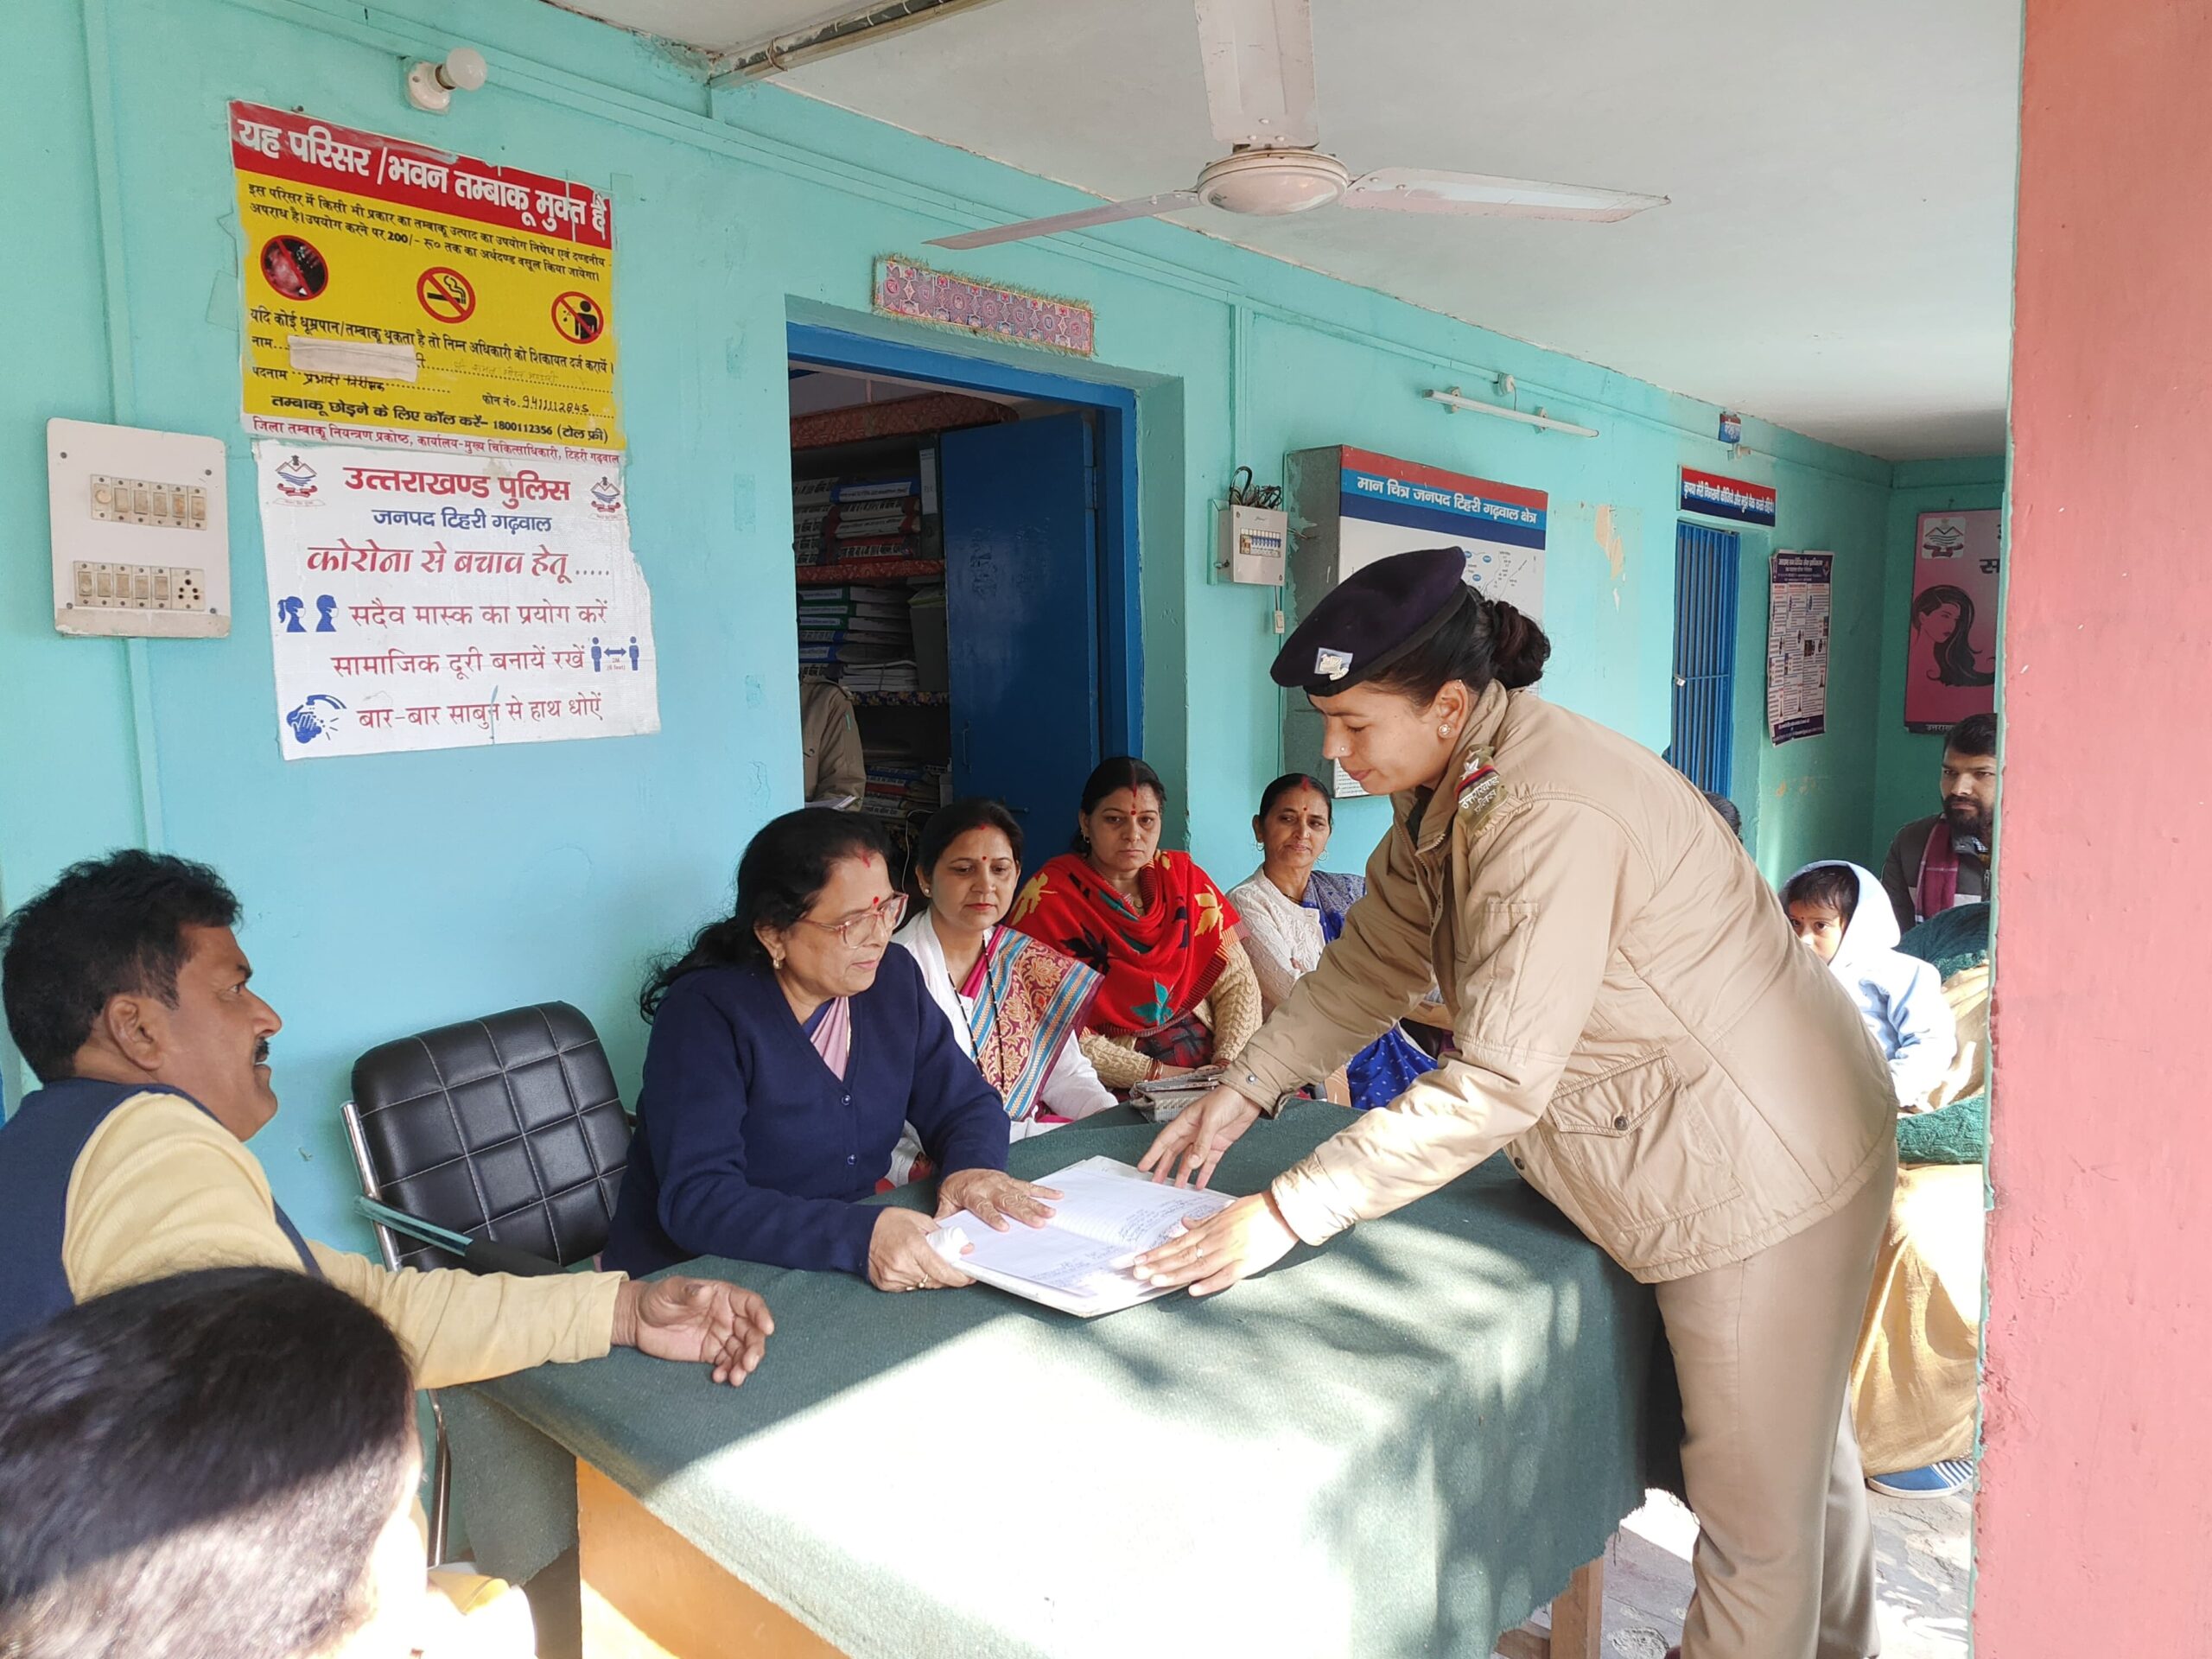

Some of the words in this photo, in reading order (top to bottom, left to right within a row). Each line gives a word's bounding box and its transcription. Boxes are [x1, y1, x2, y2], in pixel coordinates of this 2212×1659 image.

[238, 118, 282, 159] यह
[288, 125, 372, 176] परिसर
[454, 170, 537, 227] तम्बाकू
[535, 189, 587, 232] मुक्त
[249, 183, 266, 197] इस
[269, 186, 303, 207] परिसर
[305, 192, 315, 207] में
[318, 194, 347, 213] किसी
[367, 207, 396, 225] प्रकार
[397, 215, 412, 227] का
[414, 218, 448, 238] तम्बाकू
[449, 226, 478, 241] उत्पाद
[480, 232, 493, 245] का
[496, 235, 527, 251] उपयोग
[529, 239, 555, 257] निषेध
[557, 247, 570, 261] एवं
[573, 253, 606, 267] दण्डनीय
[250, 202, 289, 219] अपराध
[345, 221, 369, 237] करने
[372, 228, 387, 242] पर
[388, 231, 420, 246] 200/-
[445, 241, 461, 254] तक
[464, 246, 477, 257] का
[480, 248, 516, 264] अर्थदण्ड
[518, 257, 541, 272] वसूल
[543, 259, 566, 275] किया
[250, 305, 270, 325] यदि
[273, 308, 297, 332] कोई
[384, 328, 416, 346] थूकता
[416, 328, 425, 346] है
[428, 333, 442, 349] तो
[442, 334, 467, 353] निम्न
[470, 340, 512, 360] अधिकारी
[514, 346, 527, 360] को
[530, 346, 567, 367] शिकायत
[569, 354, 583, 370] दर्ज
[585, 357, 607, 374] करायें
[251, 366, 288, 380] पदनाम
[271, 395, 328, 416] तम्बाकू
[329, 398, 369, 418] छोड़ने
[372, 404, 389, 417] के
[392, 405, 420, 422] लिए
[424, 410, 456, 426] कॉल
[493, 420, 553, 435] 1800112356
[481, 392, 502, 406] फोन
[253, 416, 283, 432] जिला
[288, 423, 327, 442] तम्बाकू
[328, 423, 373, 442] नियन्त्रण
[564, 448, 588, 461] टिहरी
[343, 467, 491, 496] उत्तराखण्ड
[498, 469, 572, 510] पुलिस
[1357, 476, 1384, 493] मान
[1387, 479, 1411, 499] चित्र
[1413, 487, 1452, 506] जनपद
[1453, 493, 1481, 513] टिहरी
[1484, 504, 1520, 522] गढ़वाल
[1520, 507, 1537, 524] क्षेत्र
[371, 508, 436, 528] जनपद
[442, 506, 486, 530] टिहरी
[492, 514, 552, 536] गढ़वाल
[306, 537, 414, 574] कोरोना
[420, 541, 447, 574] से
[454, 550, 524, 576] बचाव
[348, 597, 405, 626] सदैव
[412, 605, 474, 626] मास्क
[480, 605, 510, 625] का
[516, 598, 570, 626] प्रयोग
[575, 598, 608, 623] करें
[330, 648, 440, 677] सामाजिक
[446, 645, 483, 680] दूरी
[489, 644, 546, 671] बनायें
[551, 644, 585, 670] रखें
[357, 708, 440, 729] बार-बार
[447, 703, 499, 729] साबुन
[505, 697, 523, 721] से
[528, 697, 561, 722] हाथ
